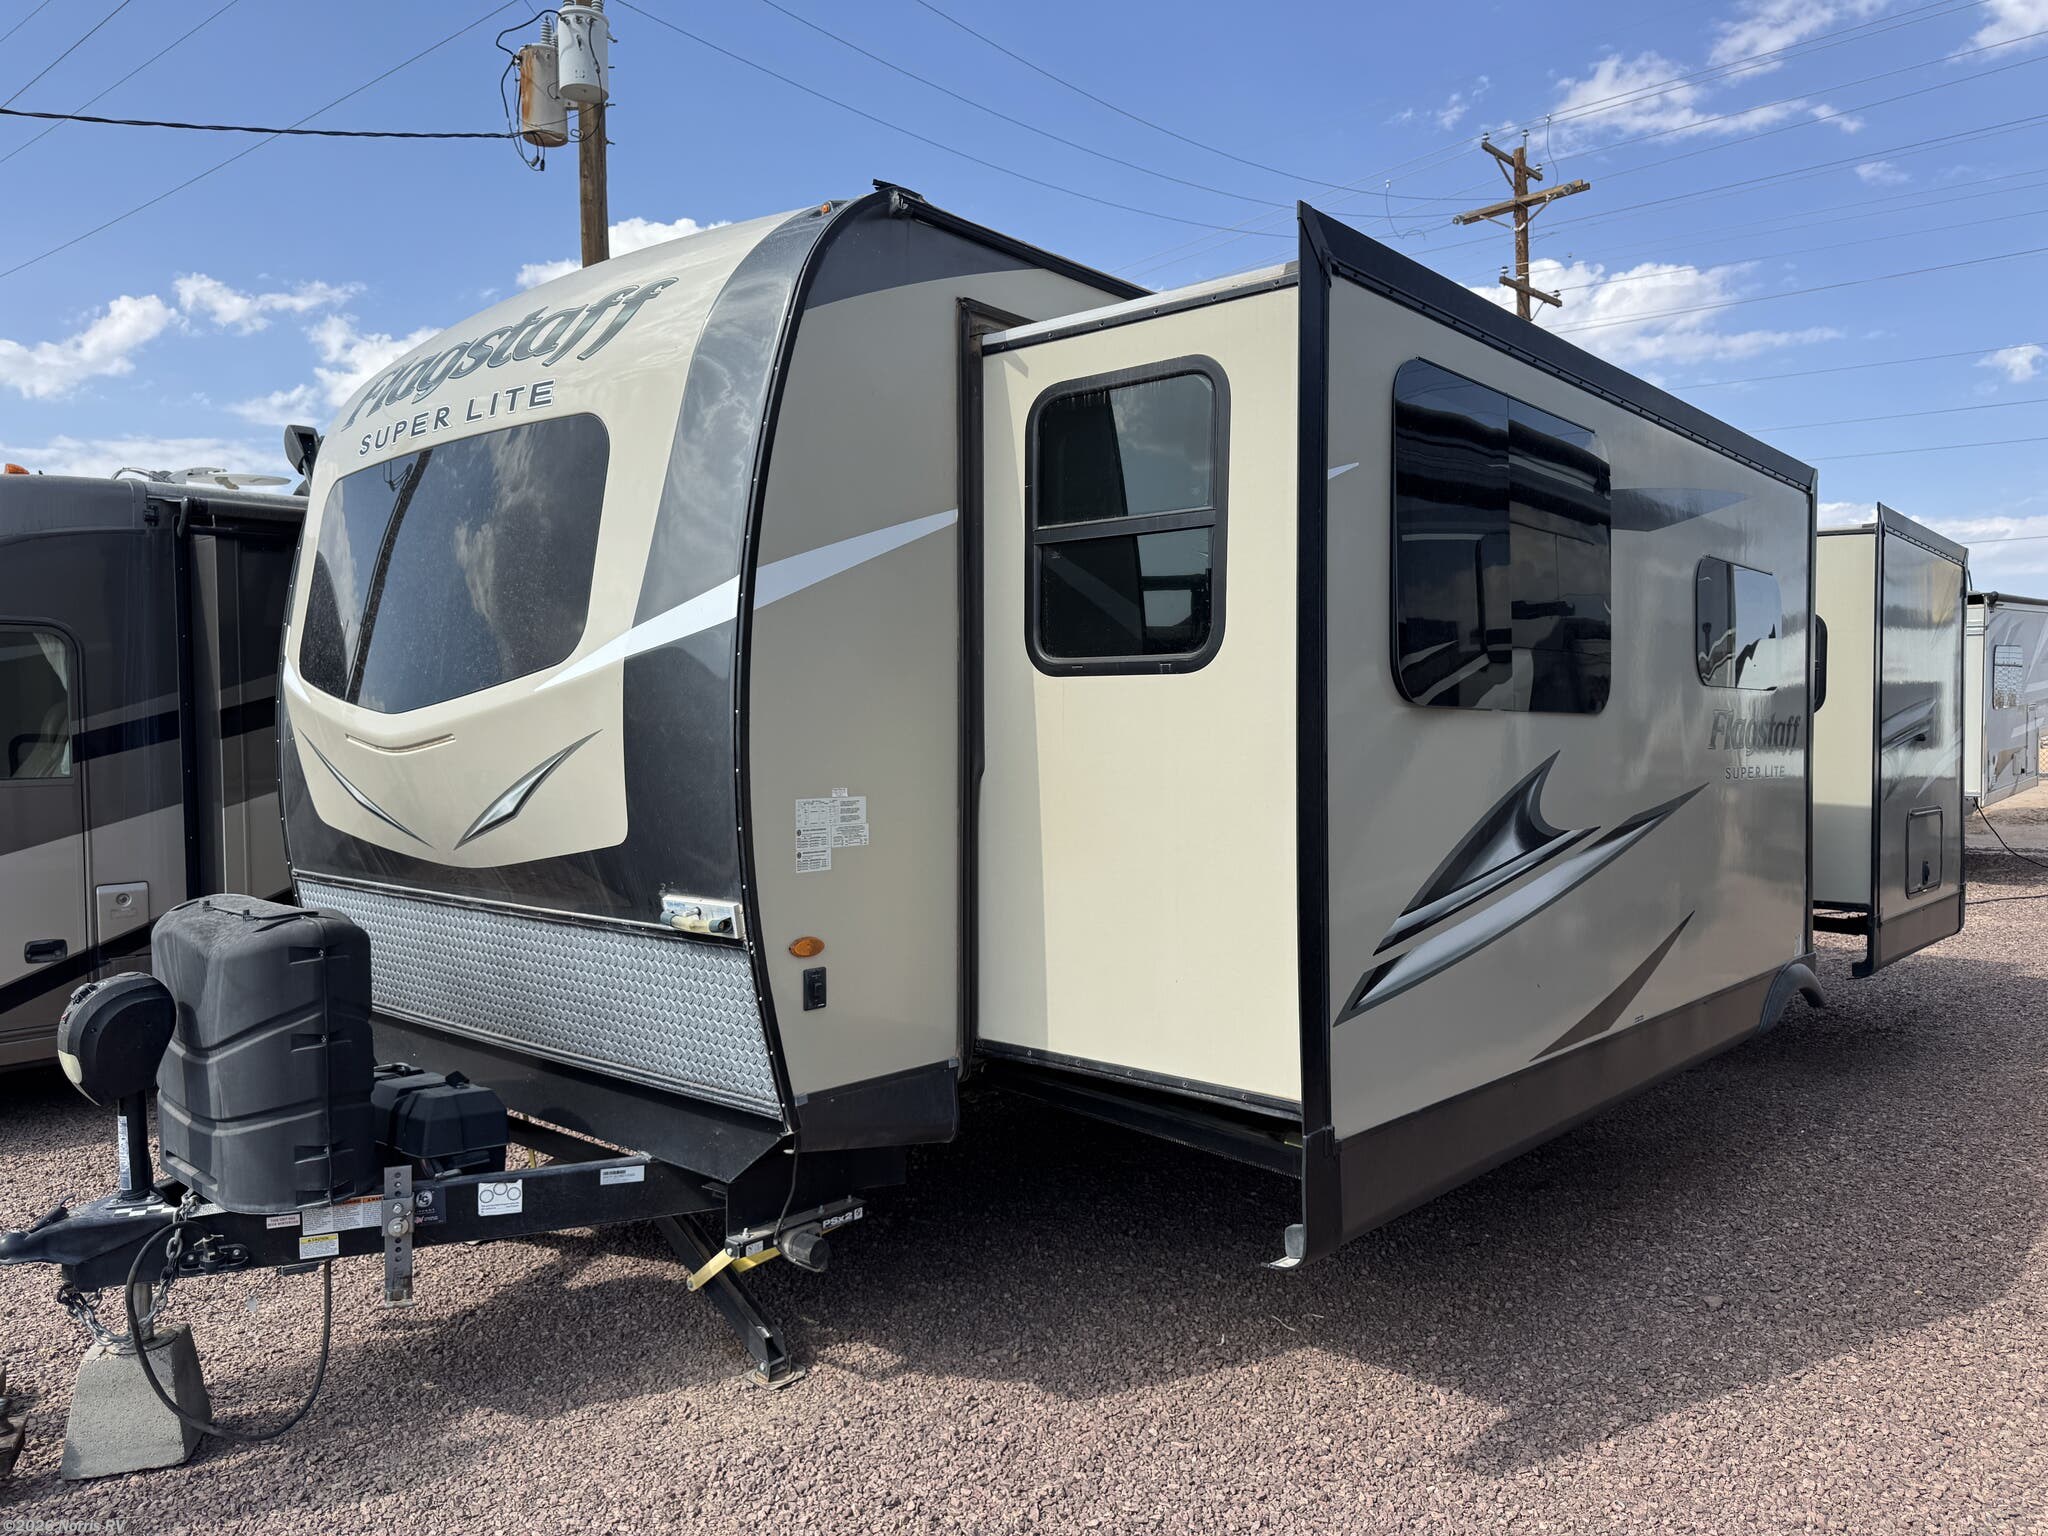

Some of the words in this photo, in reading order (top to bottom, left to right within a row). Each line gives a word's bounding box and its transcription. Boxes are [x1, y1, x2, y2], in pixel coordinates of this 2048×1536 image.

[341, 276, 679, 432] Flagstaff
[359, 405, 451, 457] SUPER
[464, 379, 557, 424] LITE
[1708, 708, 1802, 756] Flagstaff
[1725, 766, 1761, 780] SUPER
[1764, 765, 1785, 778] LITE
